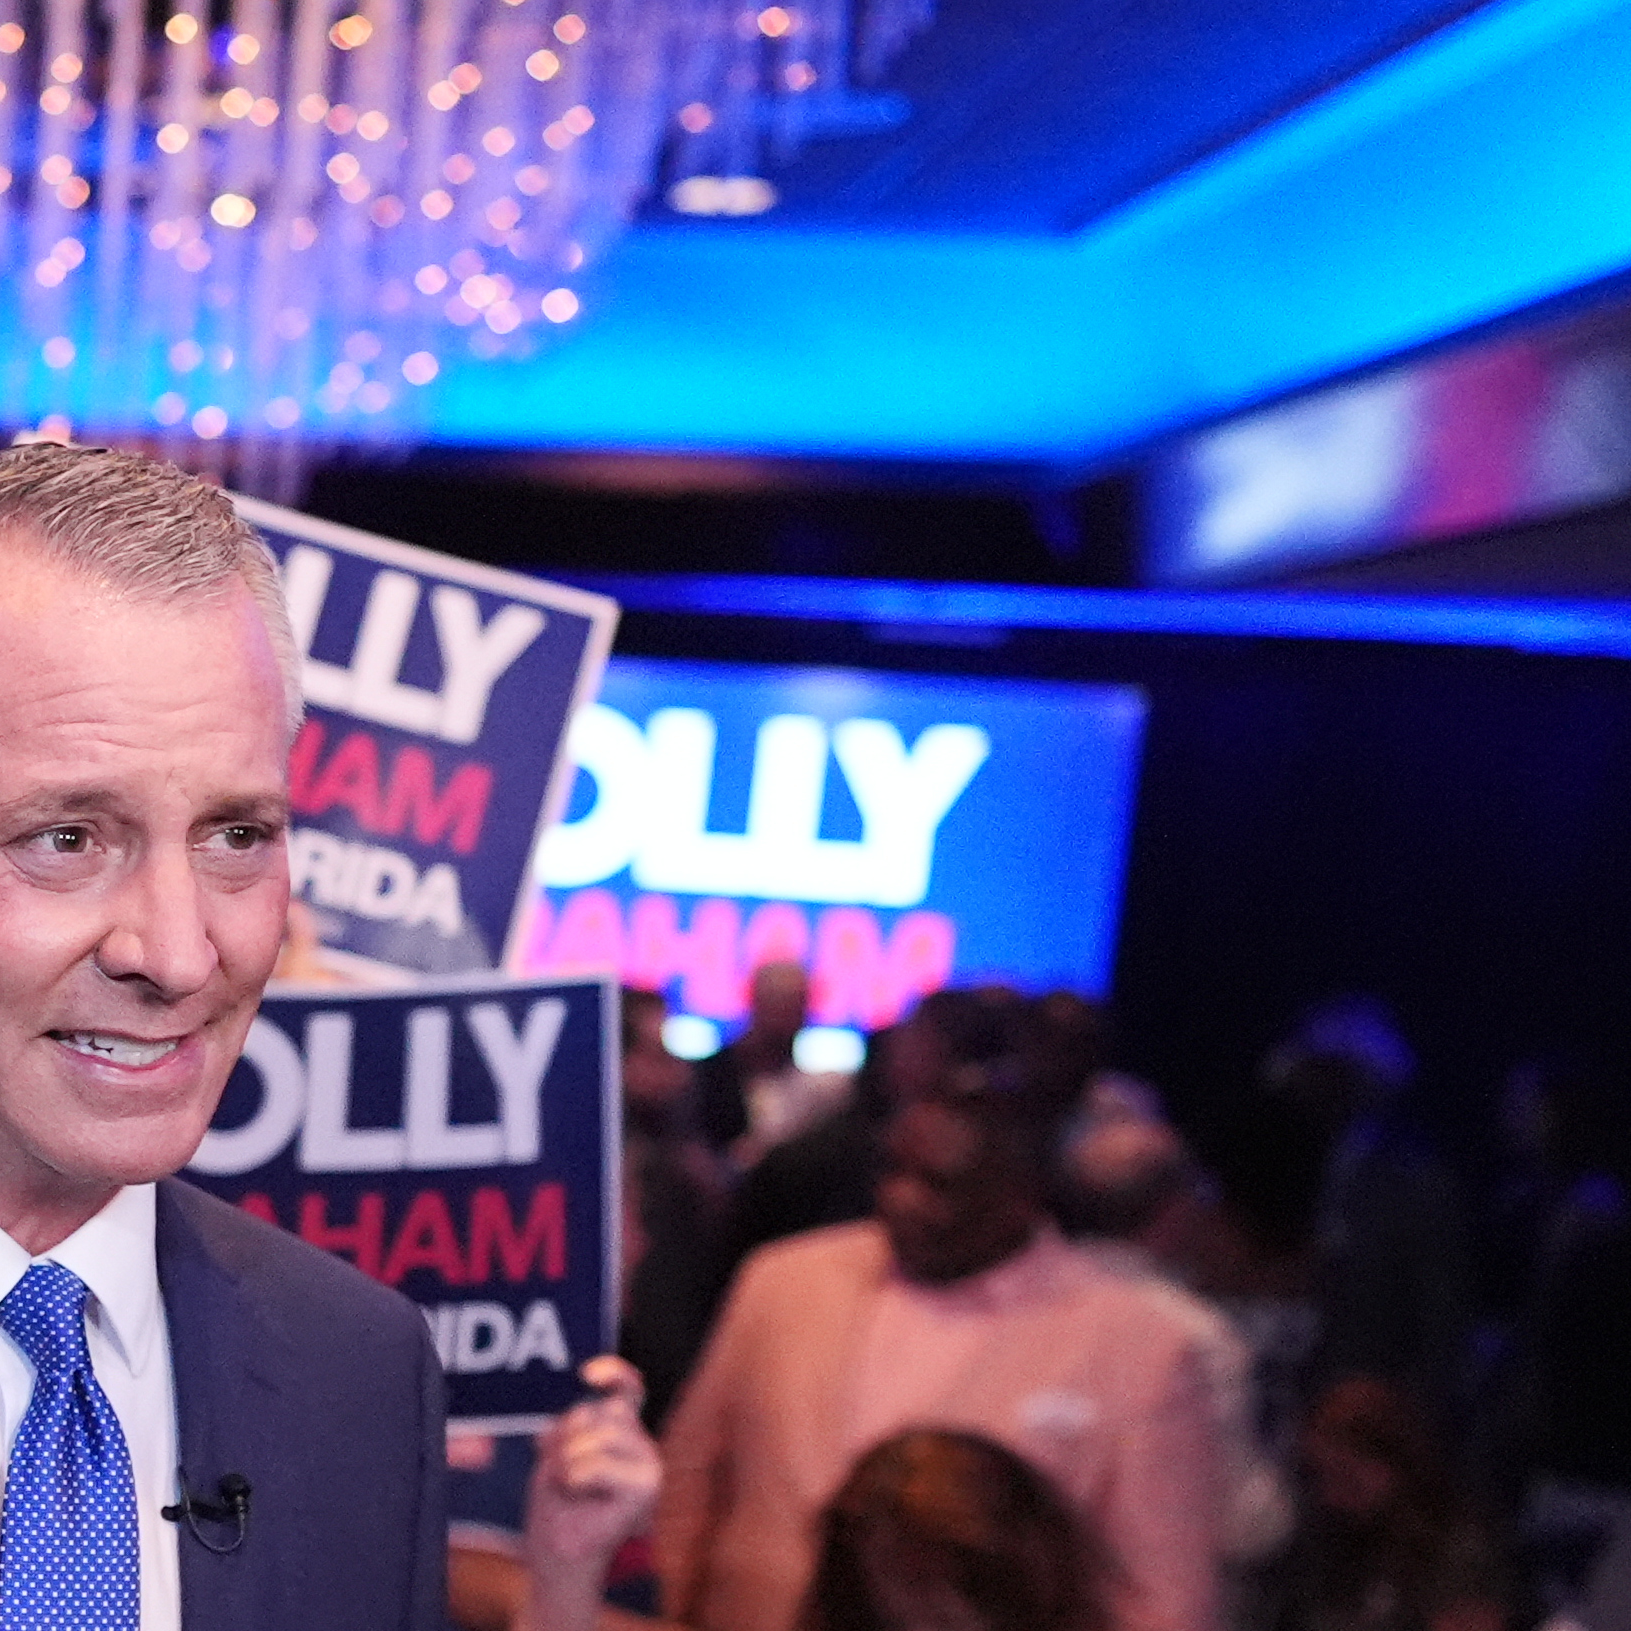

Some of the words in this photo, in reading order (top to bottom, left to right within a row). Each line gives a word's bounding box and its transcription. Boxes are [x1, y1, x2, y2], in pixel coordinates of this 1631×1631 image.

[279, 543, 545, 746] LLY
[536, 701, 992, 908] OLLY
[186, 998, 567, 1176] OLLY
[239, 1181, 567, 1287] HAM
